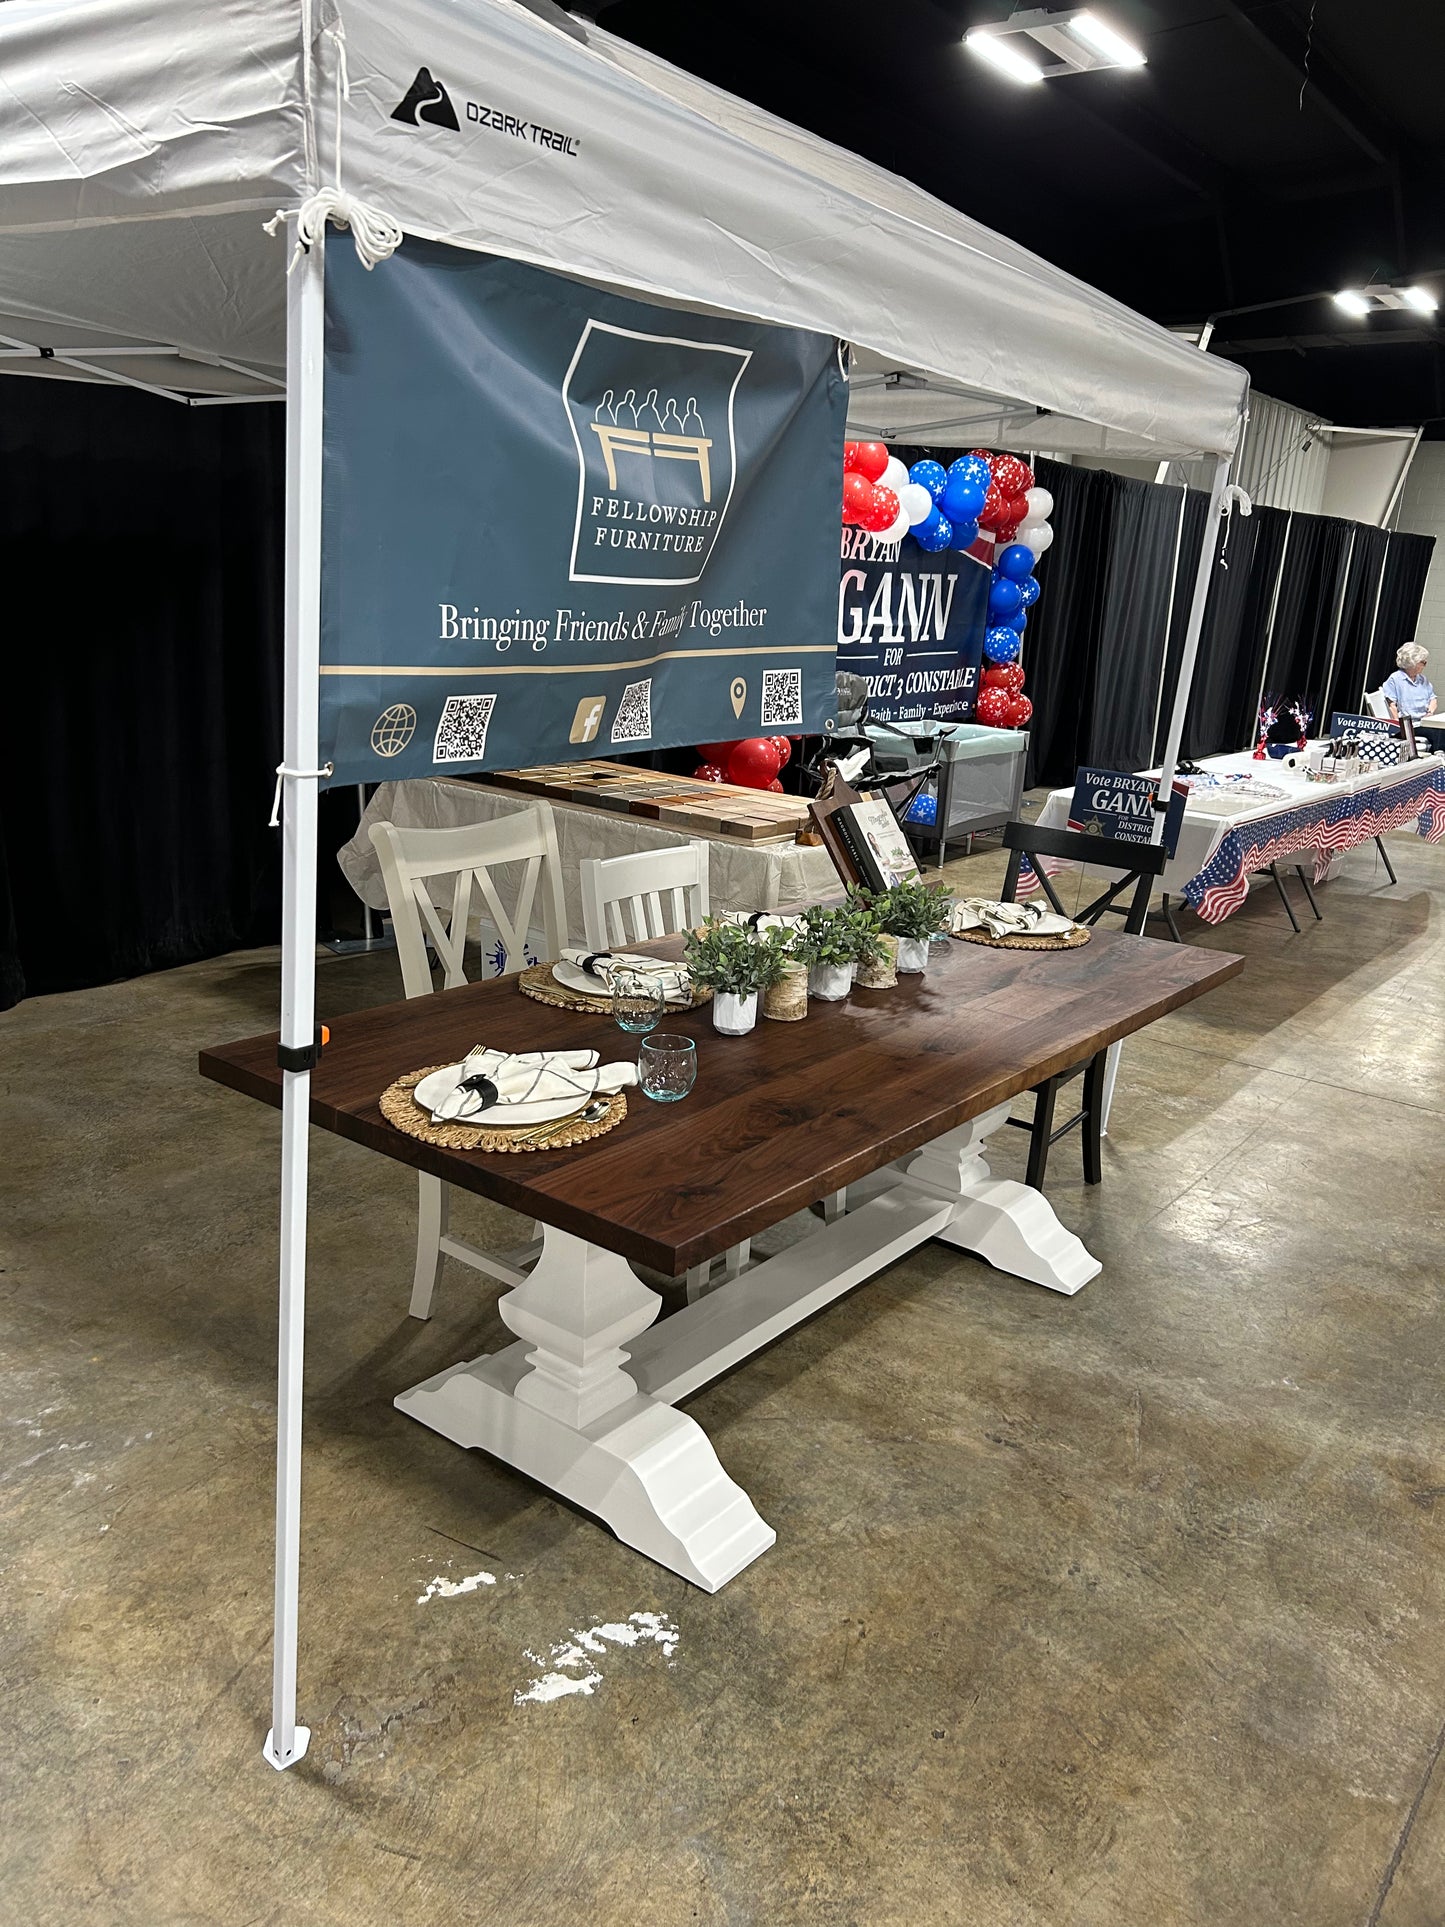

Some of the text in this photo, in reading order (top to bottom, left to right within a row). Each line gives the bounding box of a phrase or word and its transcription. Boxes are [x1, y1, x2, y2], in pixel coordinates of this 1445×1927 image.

[591, 496, 717, 527] FELLOWSHIP
[594, 527, 704, 553] FURNITURE
[840, 527, 902, 563] BRYAN
[837, 569, 959, 644] GANN
[438, 600, 767, 652] Bringing Friends & Family Together
[883, 647, 904, 666] FOR
[894, 675, 903, 700] 3
[870, 707, 891, 721] Faith
[898, 703, 926, 719] Family
[933, 699, 969, 717] Experice
[1337, 717, 1390, 731] Vote BRYAN
[1086, 772, 1156, 793] Vote BRYAN
[1091, 789, 1156, 818] GANN
[1114, 831, 1164, 847] CONSTA
[1117, 820, 1153, 834] DISTRIC
